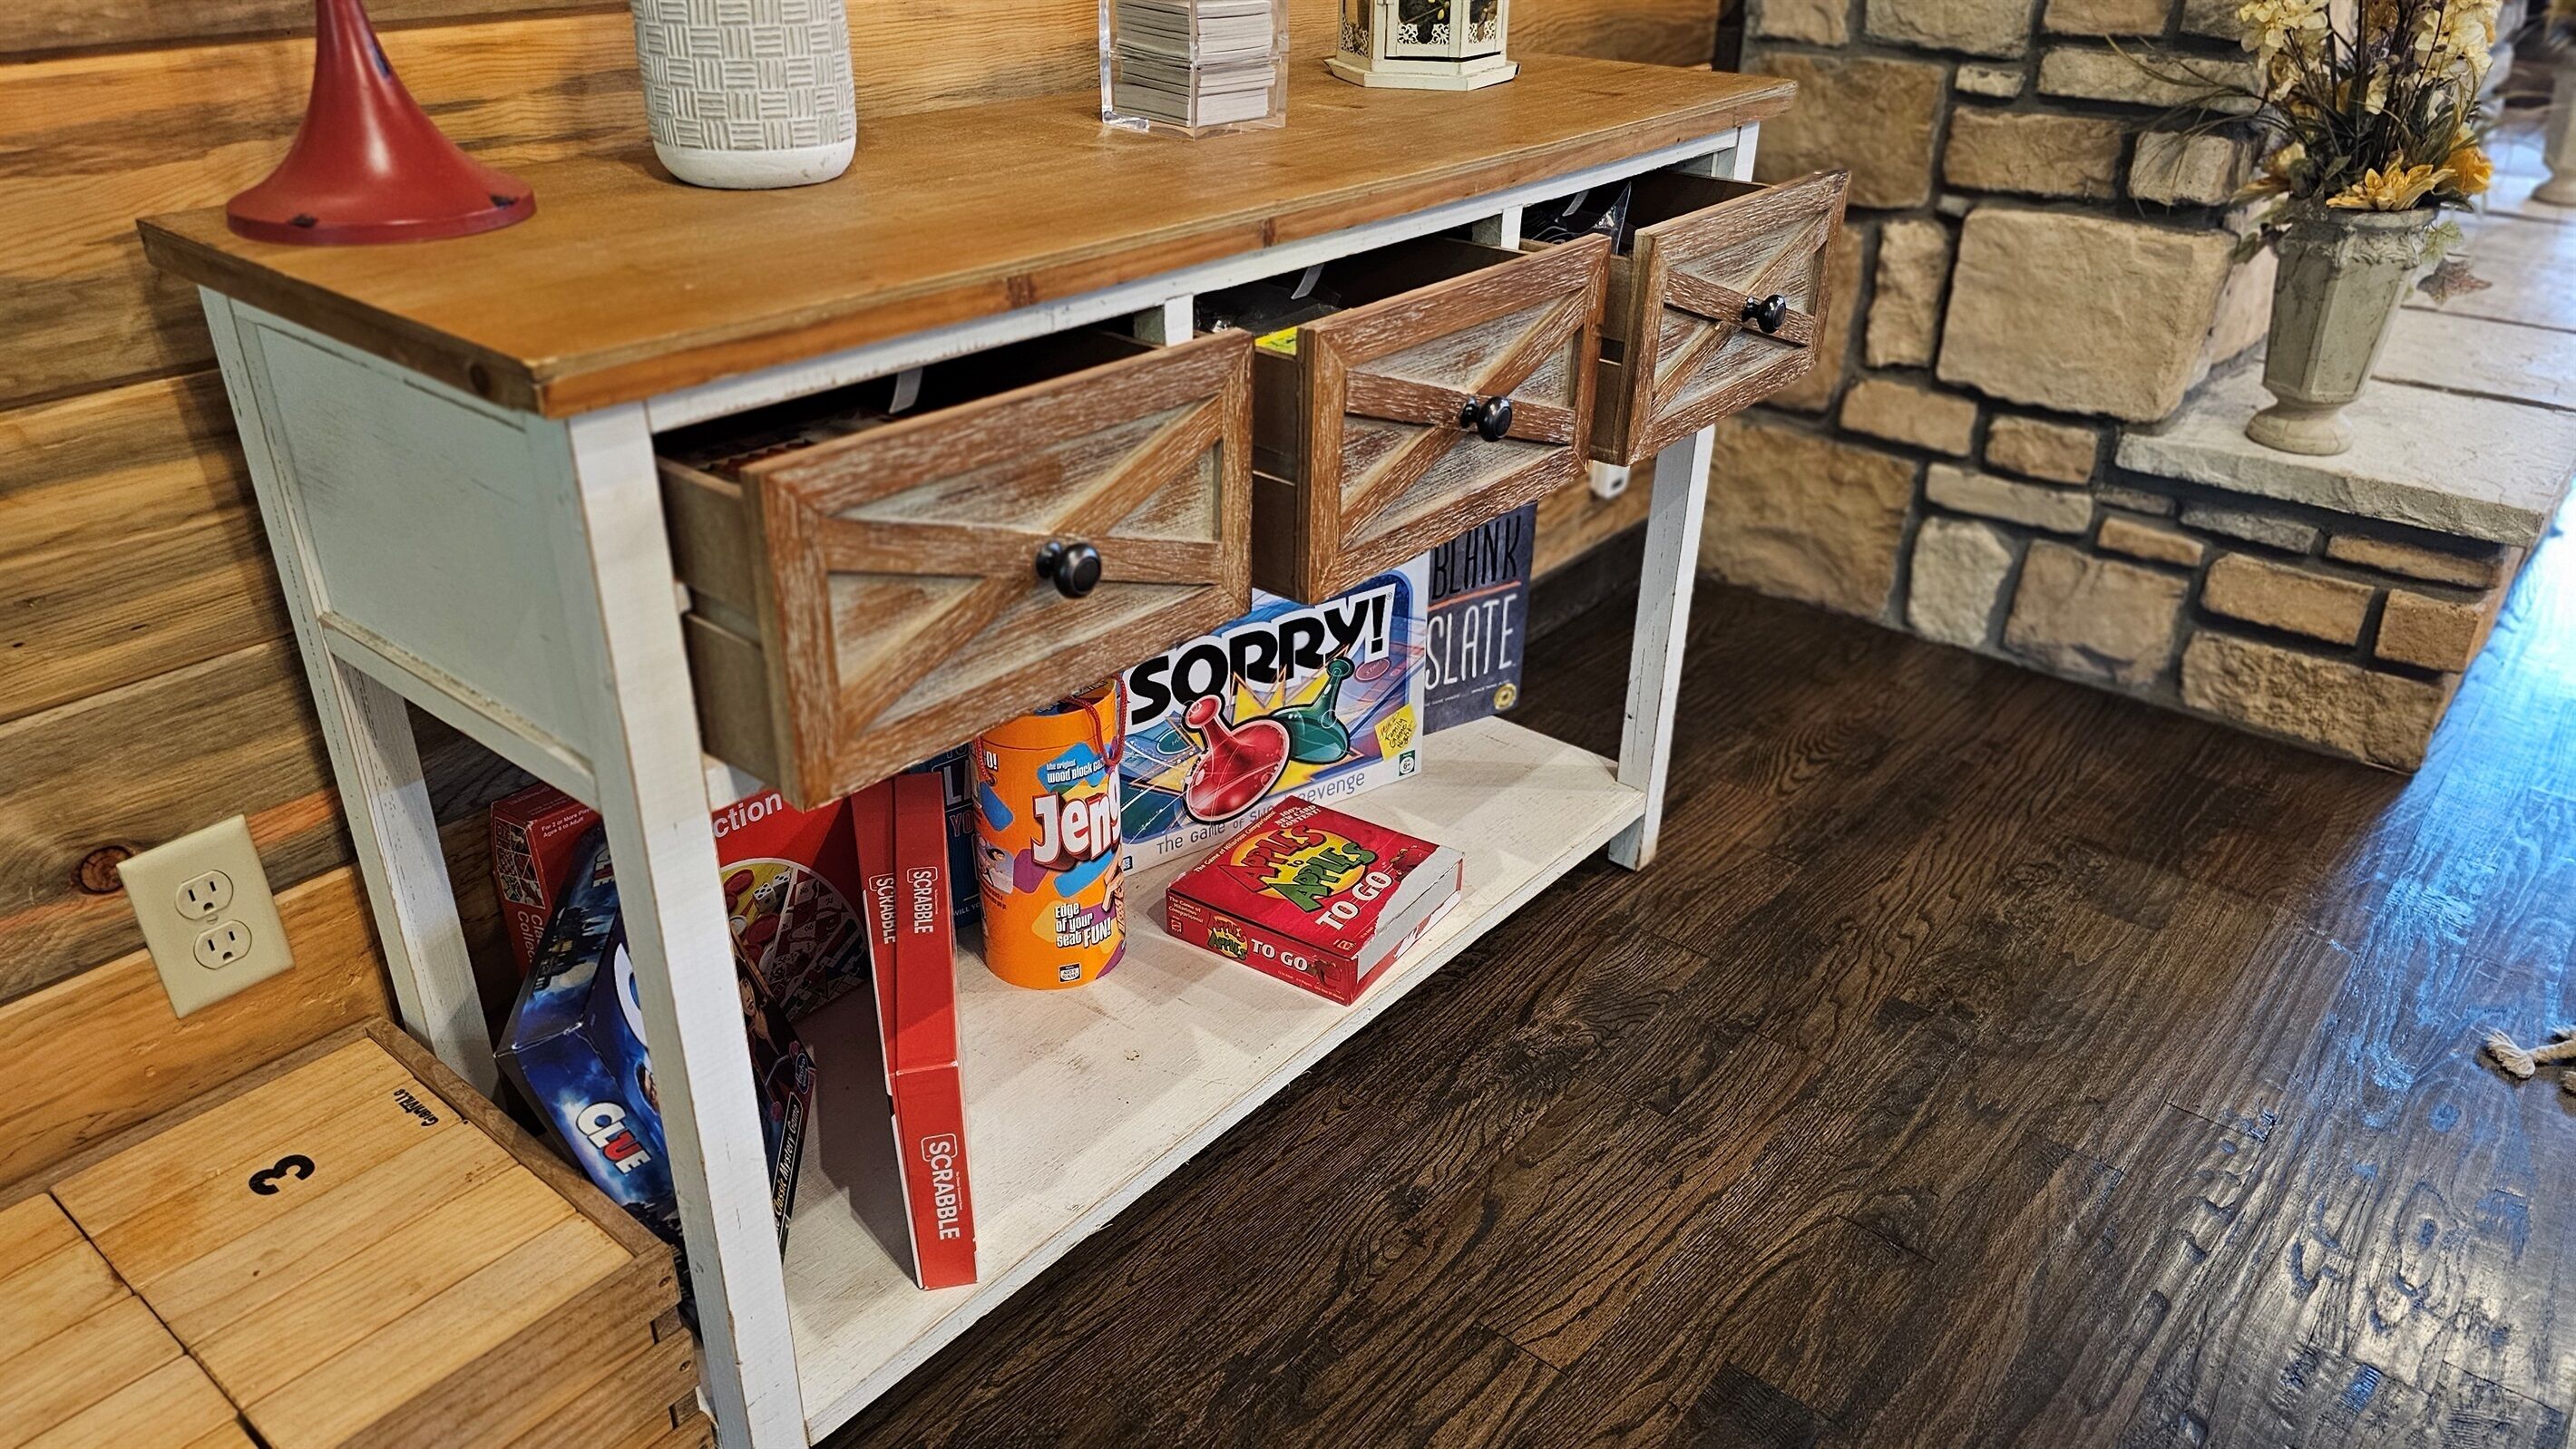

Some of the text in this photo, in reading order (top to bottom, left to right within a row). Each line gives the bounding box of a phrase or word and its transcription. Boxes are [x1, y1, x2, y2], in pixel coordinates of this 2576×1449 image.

[1431, 515, 1521, 600] BLANK
[1129, 594, 1387, 725] SORRY!
[1424, 592, 1517, 690] SLATE
[563, 813, 578, 822] More
[712, 792, 784, 839] ction
[950, 809, 973, 837] YO
[1031, 763, 1121, 866] Jeng
[1233, 819, 1244, 829] of
[1273, 804, 1316, 827] NEW CARD
[1279, 805, 1302, 817] 100%
[1281, 808, 1322, 829] CONTENT!
[1194, 863, 1206, 873] The
[1205, 853, 1220, 866] Game
[1219, 848, 1226, 856] of
[1225, 831, 1247, 851] Hilarious
[1217, 825, 1327, 893] APPLES
[1286, 860, 1304, 868] to
[1269, 841, 1379, 913] APPLES
[912, 870, 933, 934] SCRABBLE
[1055, 902, 1080, 919] Edge
[1315, 871, 1393, 930] TO GO
[517, 910, 536, 959] Collec
[531, 914, 543, 940] Cla
[1056, 912, 1093, 933] of your
[1057, 916, 1111, 948] seat FUN!
[1251, 938, 1309, 973] TO GO
[576, 1102, 652, 1174] CLUE
[787, 1104, 801, 1134] Game
[248, 1154, 316, 1196] 3
[778, 1133, 794, 1181] Mystery
[773, 1179, 788, 1217] Classic
[928, 1141, 961, 1240] SCRABBLE
